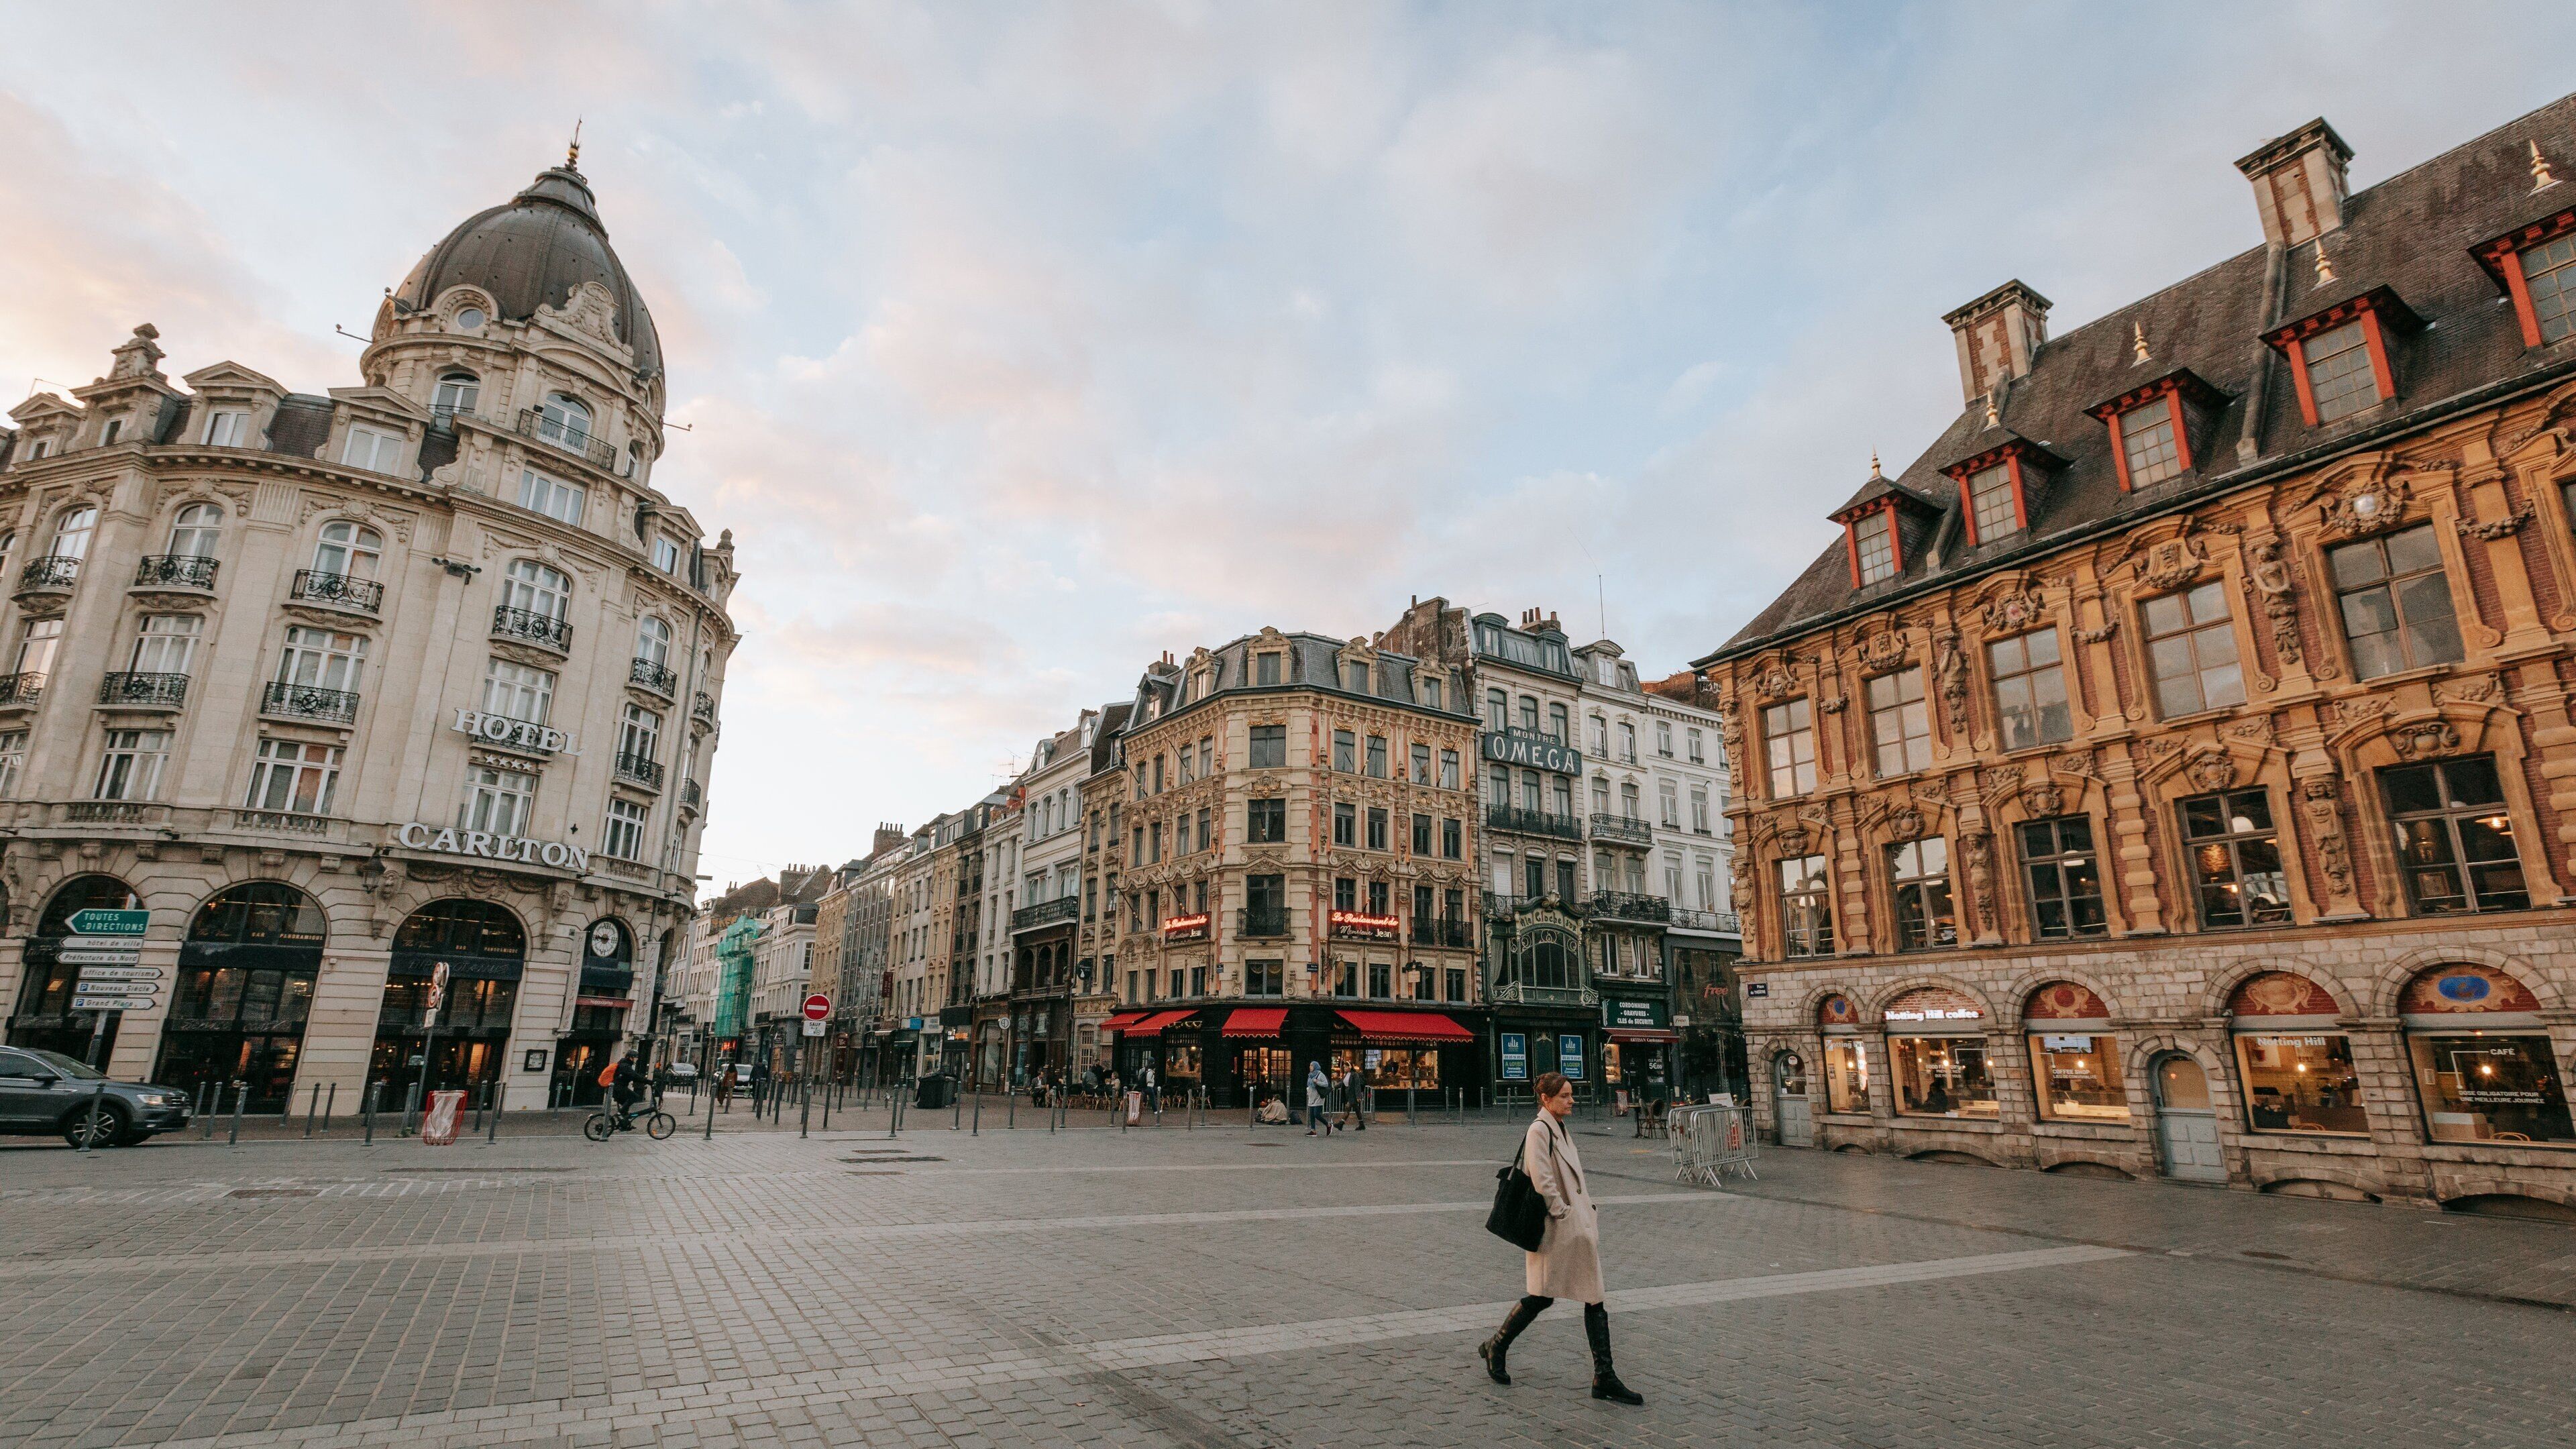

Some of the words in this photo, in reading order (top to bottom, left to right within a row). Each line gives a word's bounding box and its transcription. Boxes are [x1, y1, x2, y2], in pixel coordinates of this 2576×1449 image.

[451, 708, 584, 757] HOTEL
[1513, 729, 1555, 745] MONTRE
[1493, 736, 1574, 772] OMEGA
[399, 822, 591, 869] CARLTON
[1332, 912, 1344, 921] Le
[1344, 913, 1389, 925] Restaurant
[1389, 917, 1399, 926] de
[1340, 925, 1373, 936] Monsieur
[1375, 928, 1392, 938] Jean
[1704, 983, 1728, 998] free
[1885, 1010, 1924, 1021] Notting
[1925, 1009, 1945, 1019] Hill
[1945, 1008, 1979, 1018] coffee
[2257, 1037, 2302, 1047] Notting
[2304, 1036, 2326, 1046] Hill
[2490, 1047, 2515, 1055] CAFÉ
